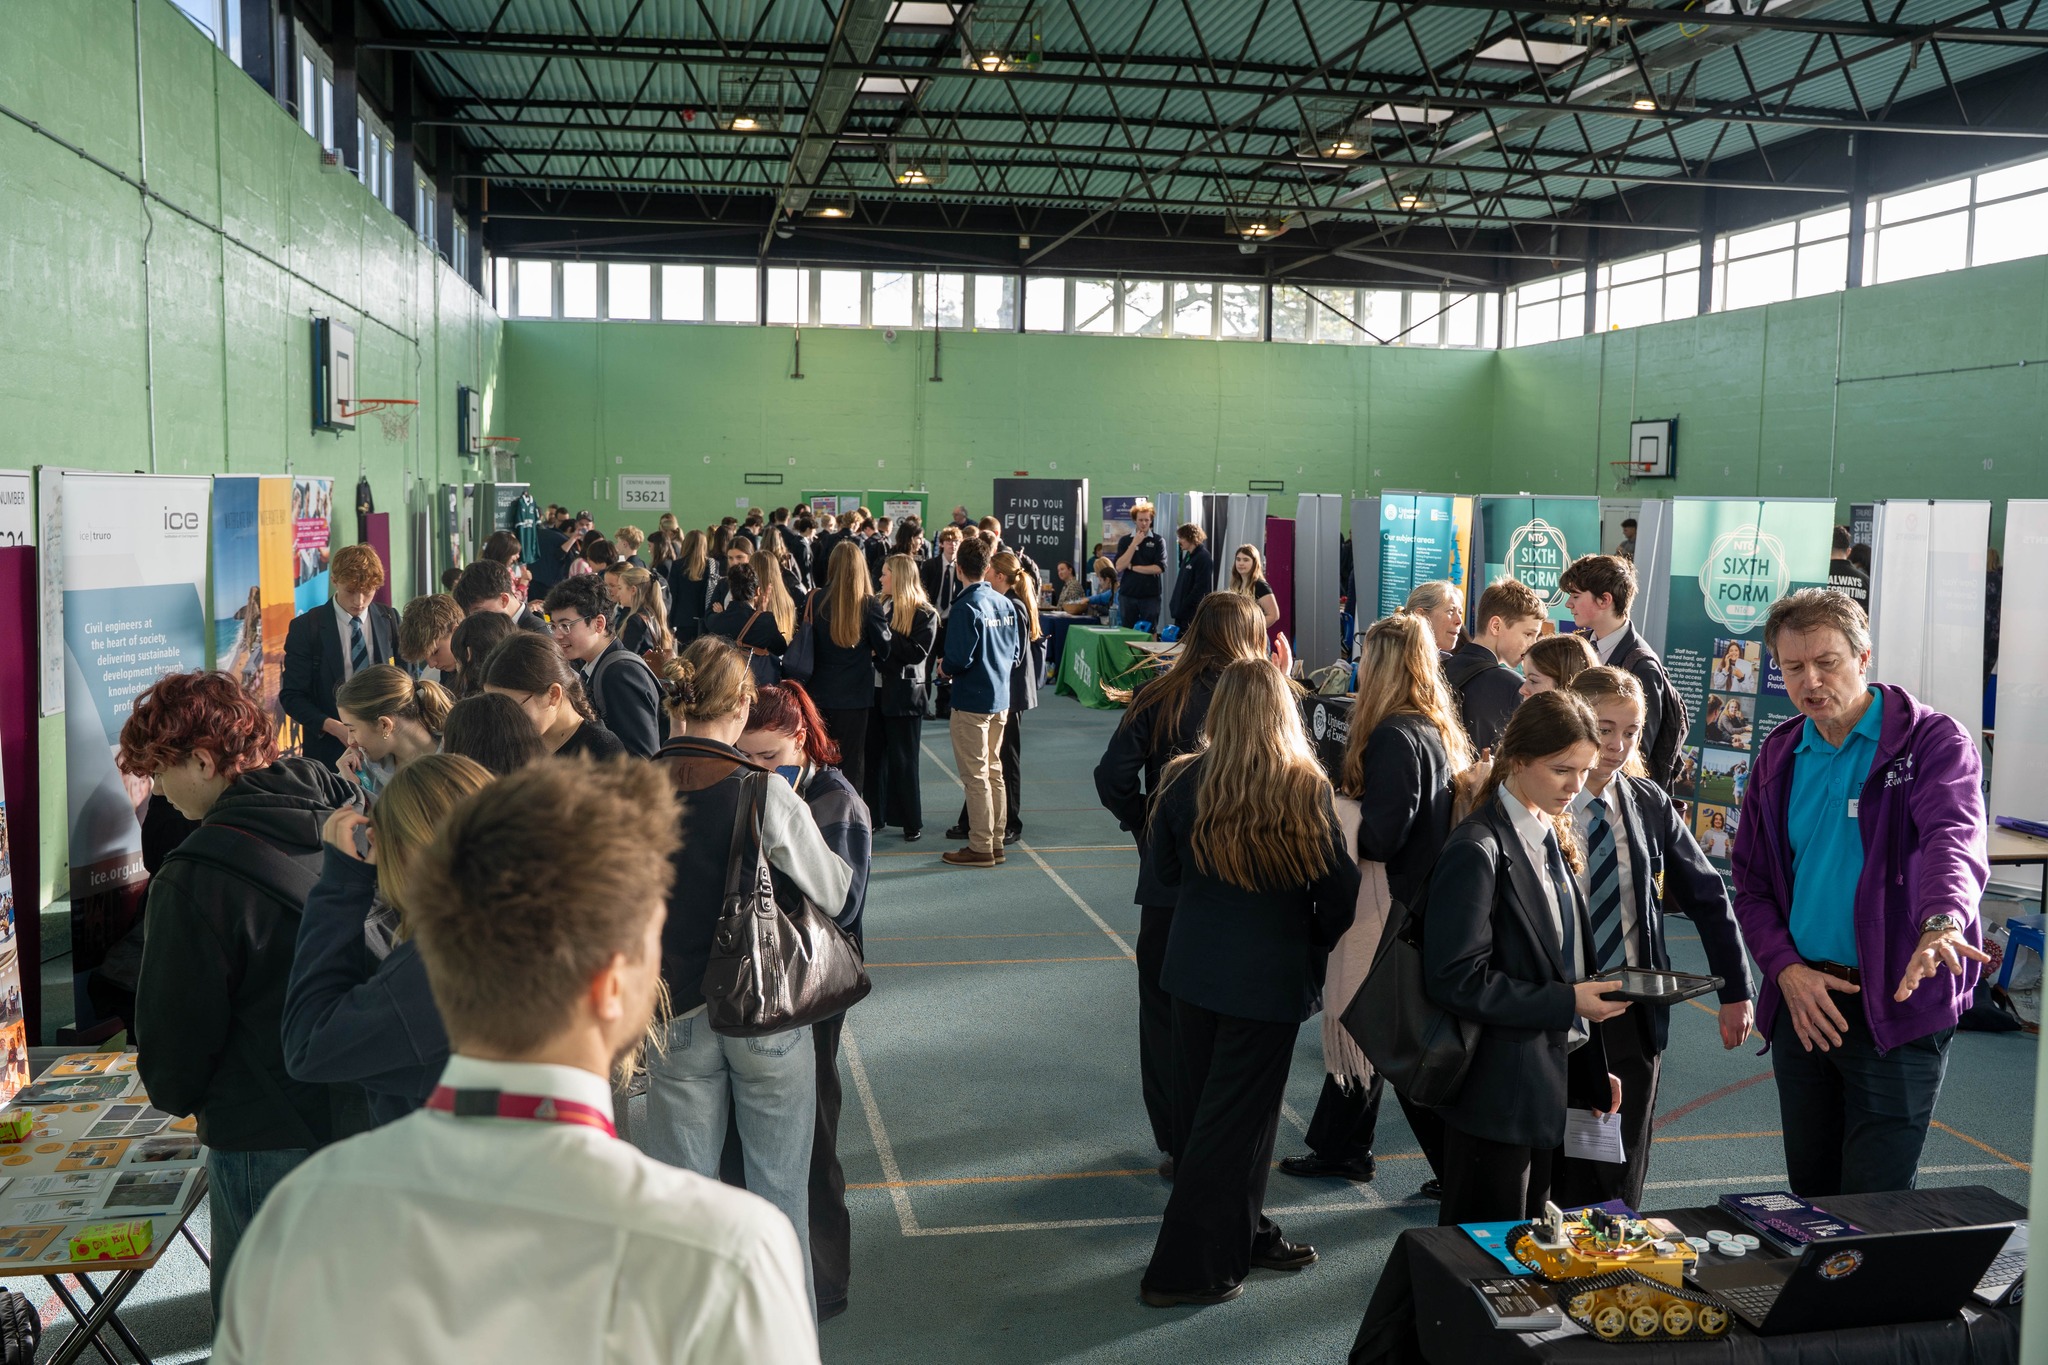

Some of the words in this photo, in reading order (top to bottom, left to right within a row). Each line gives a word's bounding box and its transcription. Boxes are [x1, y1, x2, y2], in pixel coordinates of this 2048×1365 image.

[626, 491, 665, 502] 53621
[1010, 498, 1038, 508] FIND
[1043, 500, 1063, 509] YOUR
[164, 506, 198, 530] ice
[1004, 513, 1065, 532] FUTURE
[1018, 535, 1031, 544] IN
[1036, 535, 1059, 546] FOOD
[1396, 534, 1416, 544] subject
[1522, 548, 1556, 564] SIXTH
[1723, 557, 1770, 576] SIXTH
[1520, 570, 1558, 587] FORM
[1828, 575, 1862, 587] ALWAYS
[1718, 583, 1769, 602] FORM
[84, 622, 102, 634] Civil
[105, 620, 142, 634] engineers
[144, 619, 152, 628] at
[1003, 616, 1014, 626] NT
[91, 639, 104, 650] the
[106, 637, 126, 649] heart
[129, 634, 137, 646] of
[140, 633, 167, 645] society,
[97, 652, 136, 666] delivering
[138, 647, 180, 660] sustainable
[103, 666, 152, 681] development
[154, 661, 184, 675] through
[90, 857, 145, 886] ice.org.uk
